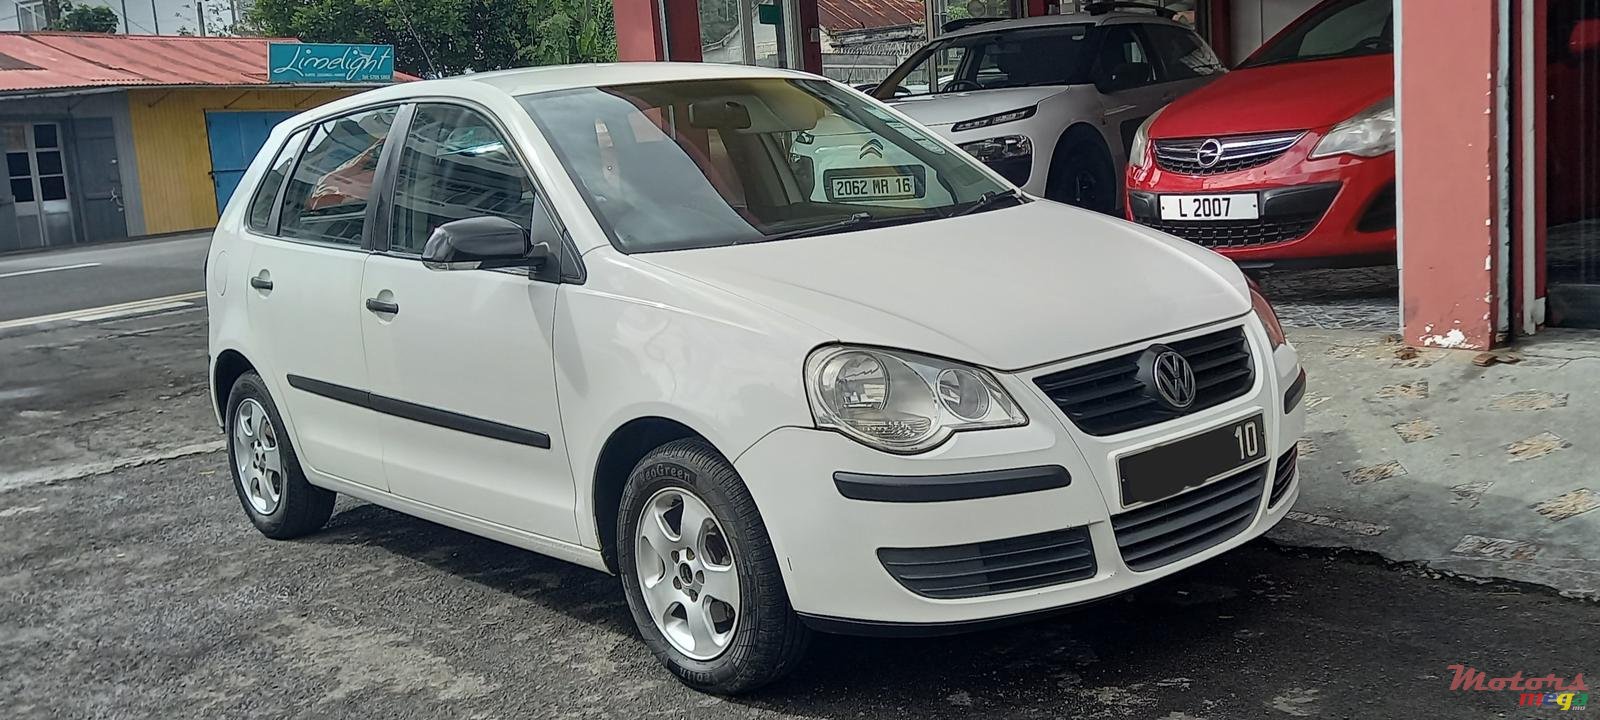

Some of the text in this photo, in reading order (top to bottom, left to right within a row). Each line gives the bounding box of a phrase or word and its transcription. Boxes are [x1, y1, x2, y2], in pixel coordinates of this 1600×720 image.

[273, 46, 391, 81] Limelight
[836, 178, 911, 196] 2062 MR 16
[1178, 197, 1231, 217] L 2007
[1233, 421, 1258, 460] 10
